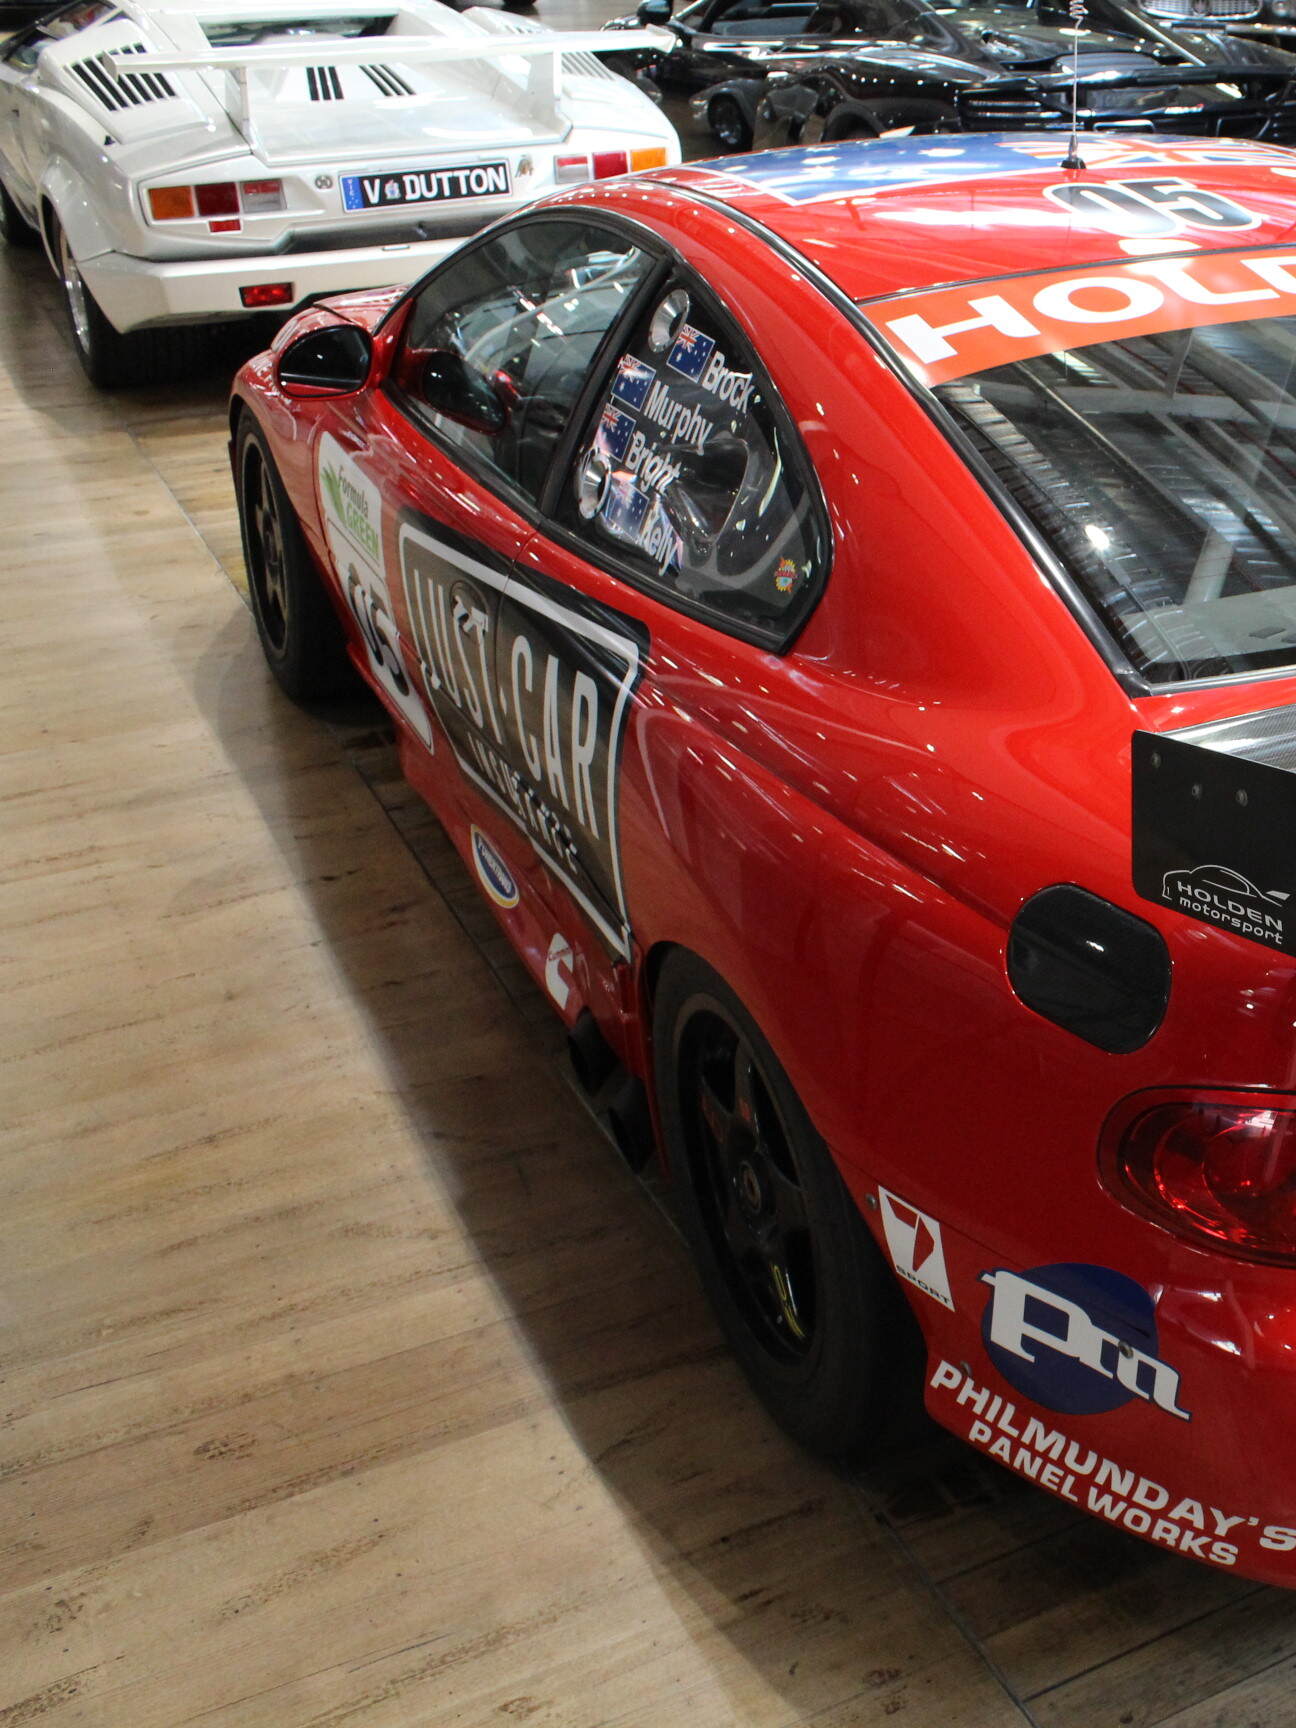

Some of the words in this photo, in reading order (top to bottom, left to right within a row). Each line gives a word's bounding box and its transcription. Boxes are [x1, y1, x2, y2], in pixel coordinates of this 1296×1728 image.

[363, 178, 381, 204] V
[402, 165, 508, 201] DUTTON
[1042, 177, 1263, 238] 05
[702, 351, 756, 414] Brock
[644, 380, 714, 456] Murphy
[338, 463, 370, 519] Formula
[625, 431, 682, 496] Bright
[346, 502, 379, 560] GREEN
[639, 501, 678, 577] Kelly
[414, 568, 503, 745] JUST
[511, 634, 600, 841] CAR
[1176, 880, 1284, 932] HOLDEN
[1179, 896, 1284, 945] motorsport
[896, 1264, 951, 1304] SPORT
[968, 1419, 1079, 1502] PANEL
[1086, 1489, 1239, 1566] WORKS
